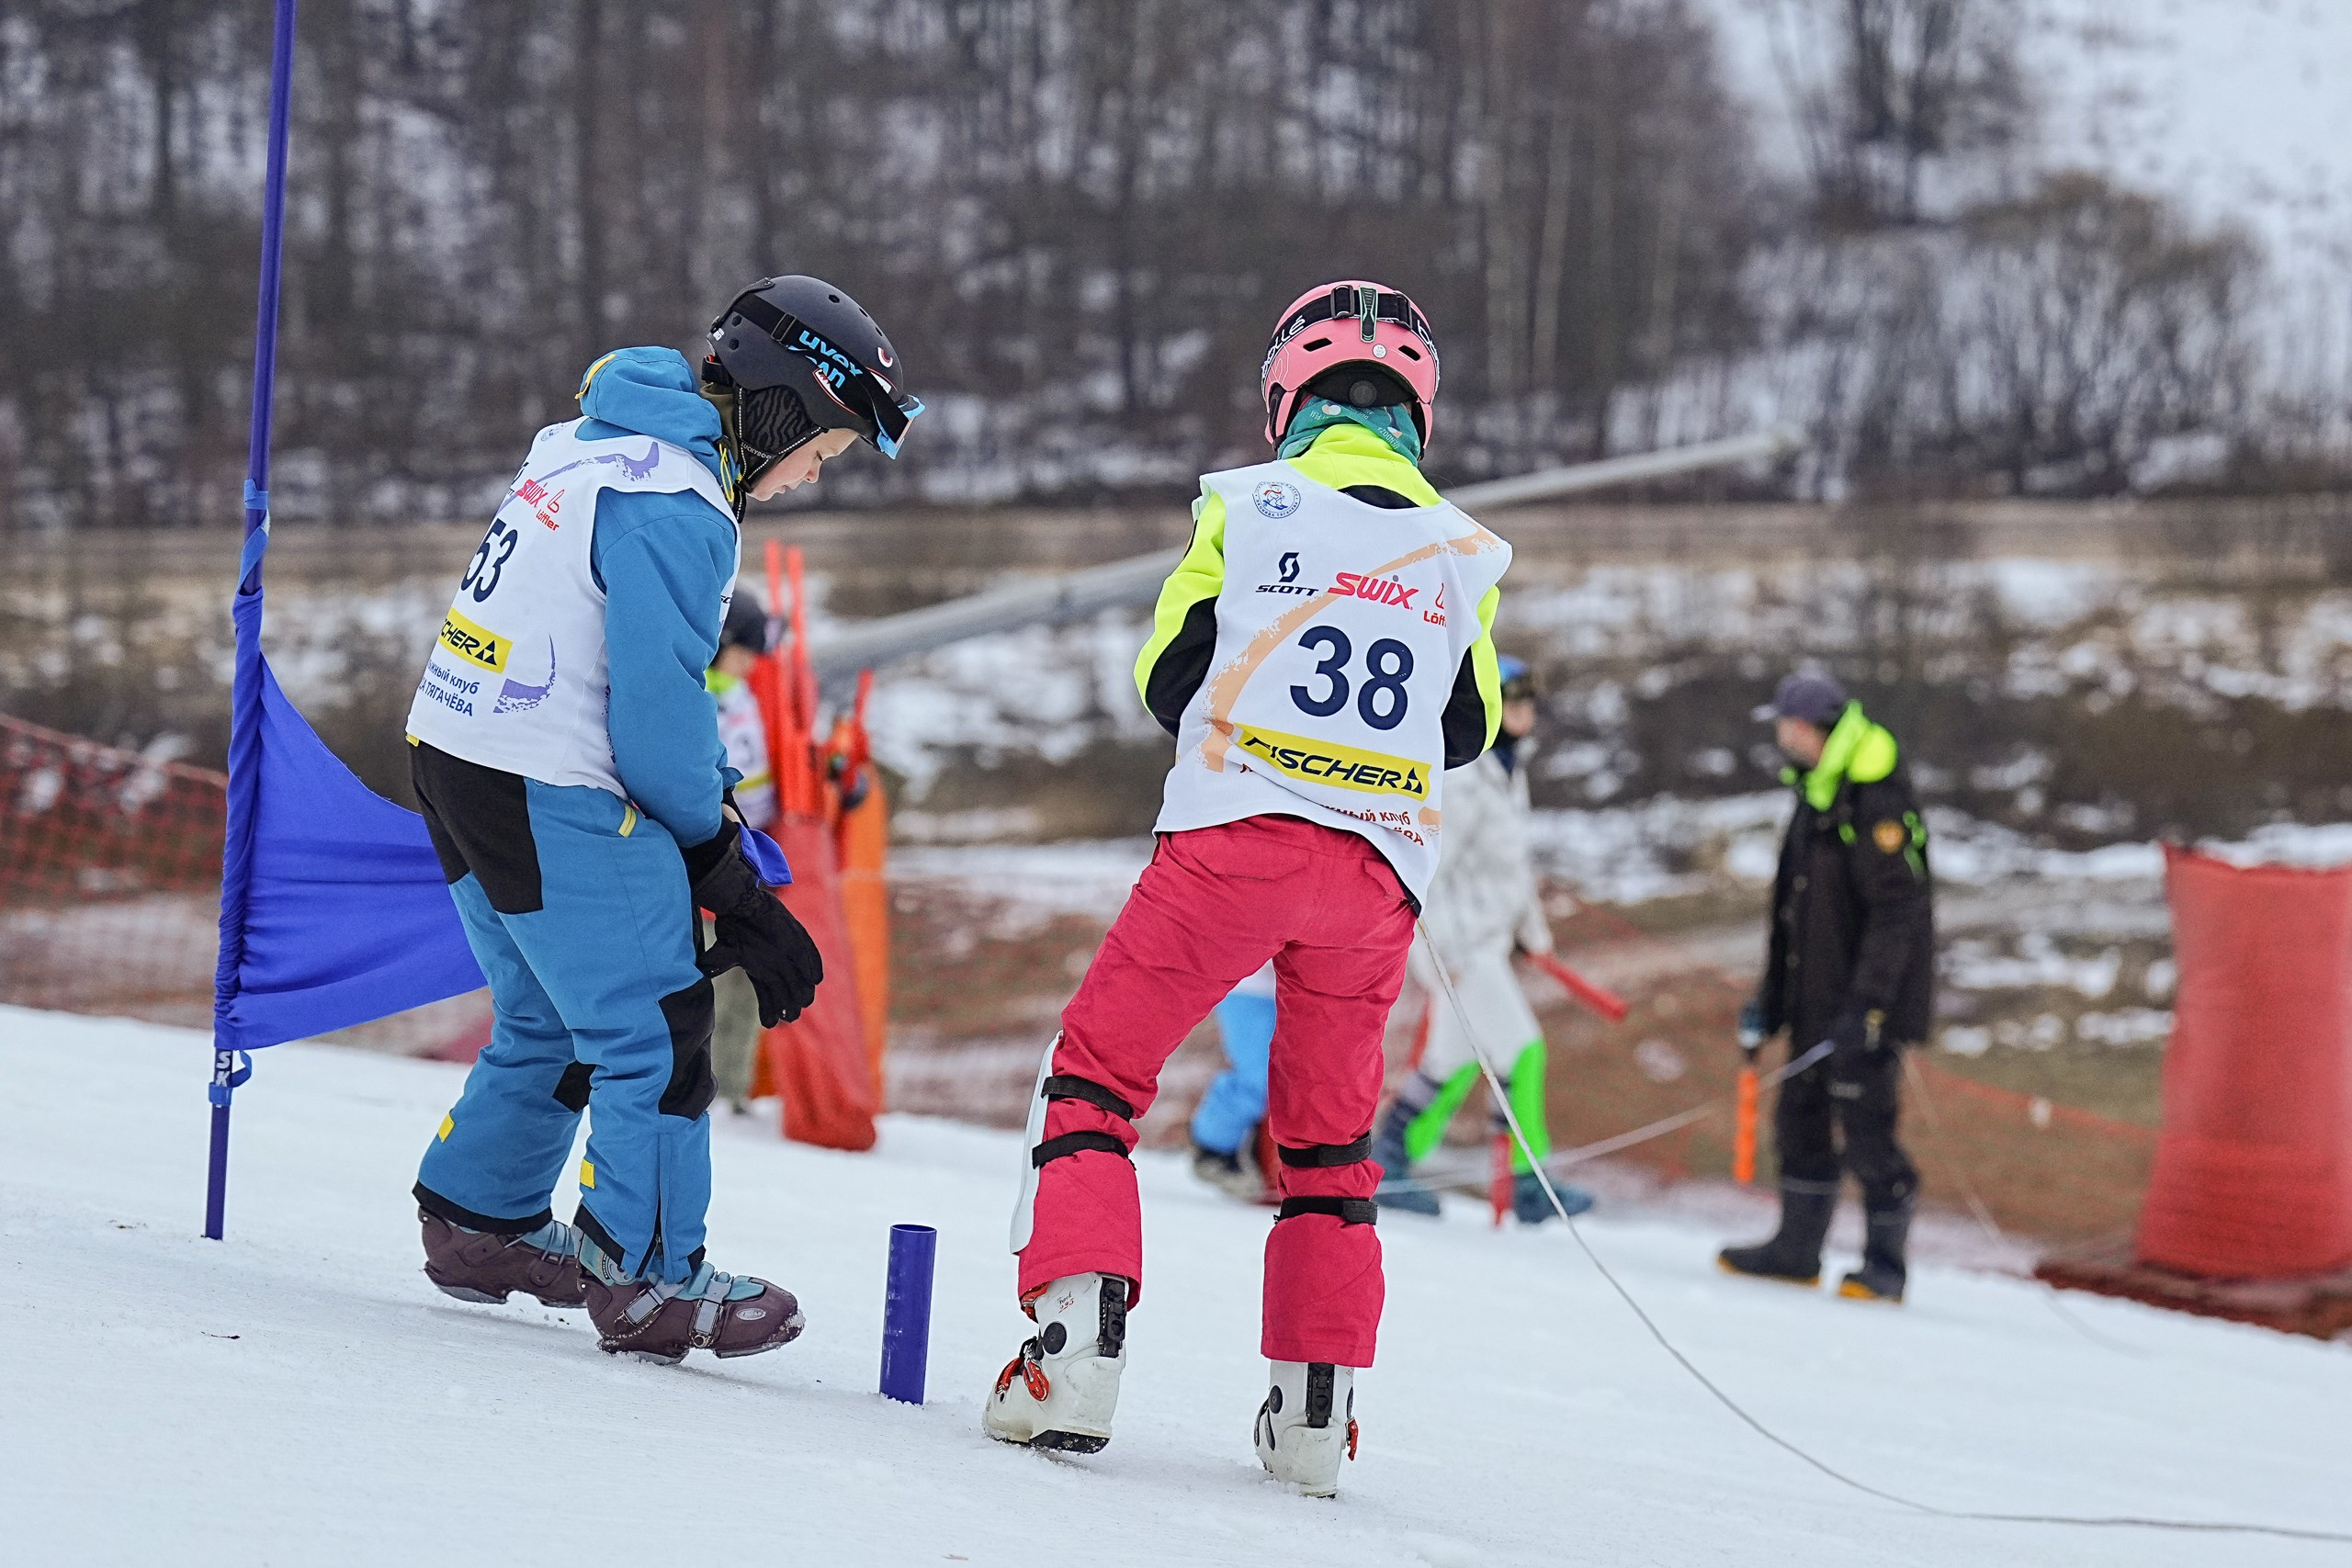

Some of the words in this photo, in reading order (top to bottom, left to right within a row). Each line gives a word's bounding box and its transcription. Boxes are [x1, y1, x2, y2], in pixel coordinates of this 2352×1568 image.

[460, 517, 518, 603] 53
[1255, 584, 1319, 597] SCOTT
[449, 674, 481, 694] клуб
[1289, 626, 1414, 731] 38
[424, 682, 473, 716] ТЯГАЧЁВА
[1381, 810, 1411, 826] клуб
